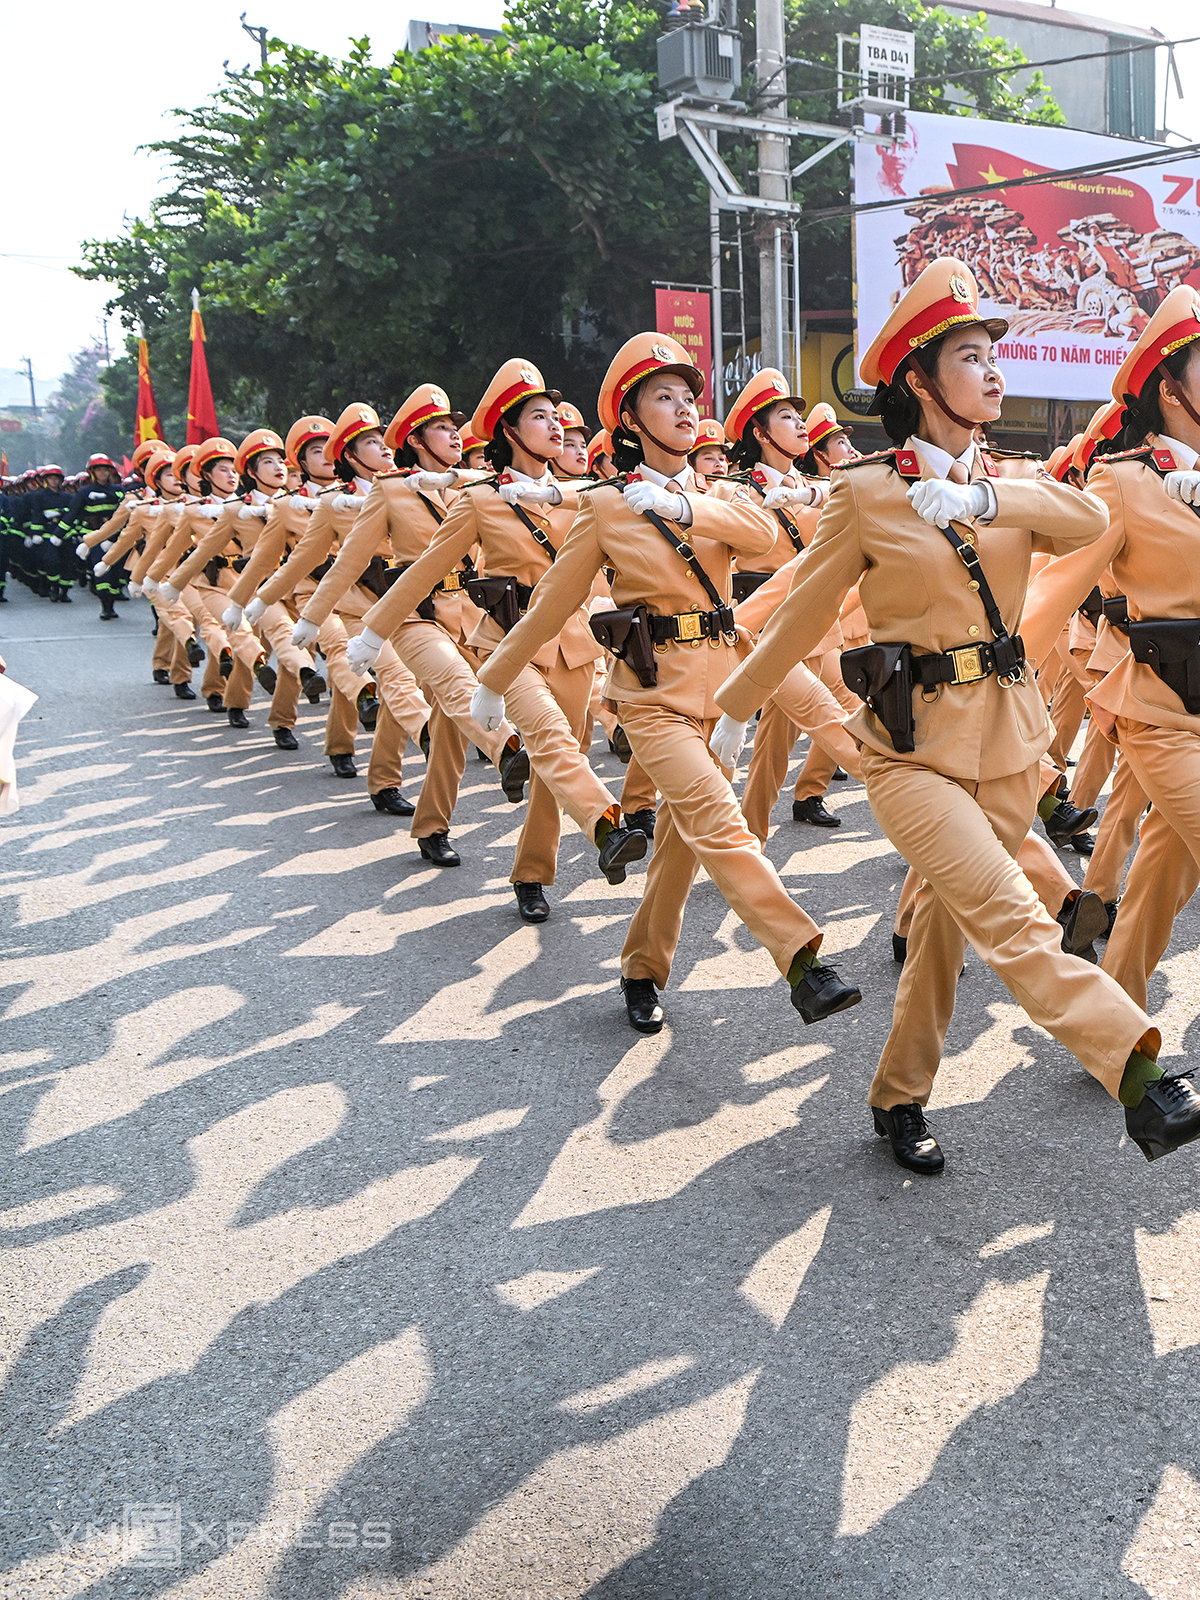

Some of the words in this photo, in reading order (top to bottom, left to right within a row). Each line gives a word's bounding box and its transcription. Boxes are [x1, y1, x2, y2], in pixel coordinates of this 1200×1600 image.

[867, 45, 887, 60] TBA
[891, 49, 909, 65] D41
[673, 314, 695, 329] NƯỚC
[998, 340, 1038, 360] MỪNG
[1041, 346, 1057, 362] 70
[1061, 345, 1091, 364] NĂM
